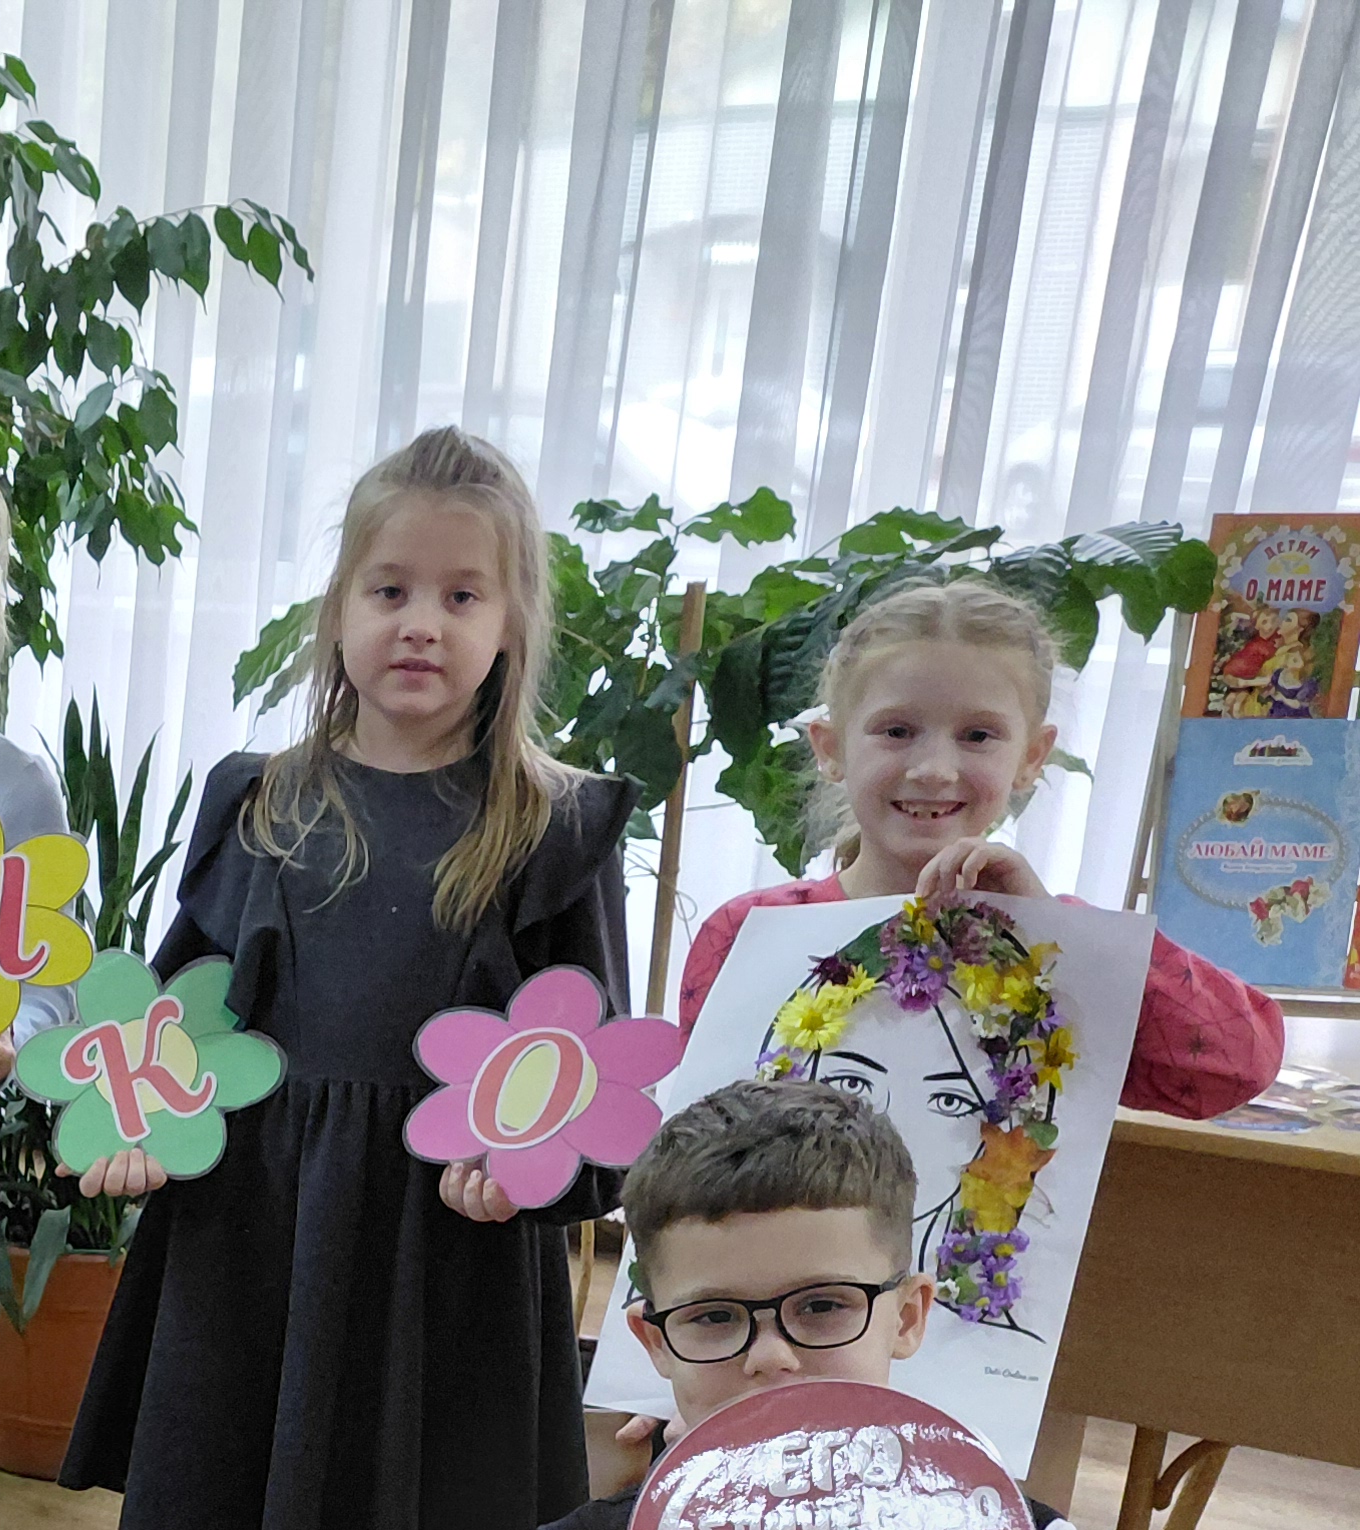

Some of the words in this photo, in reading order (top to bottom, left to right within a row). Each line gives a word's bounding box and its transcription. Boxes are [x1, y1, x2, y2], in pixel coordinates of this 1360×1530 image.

[1264, 539, 1320, 560] ДЕТЯМ
[1245, 578, 1259, 601] О
[1266, 578, 1327, 602] МАМЕ
[1270, 844, 1332, 859] МАМЕ
[768, 1425, 903, 1497] ЕГО
